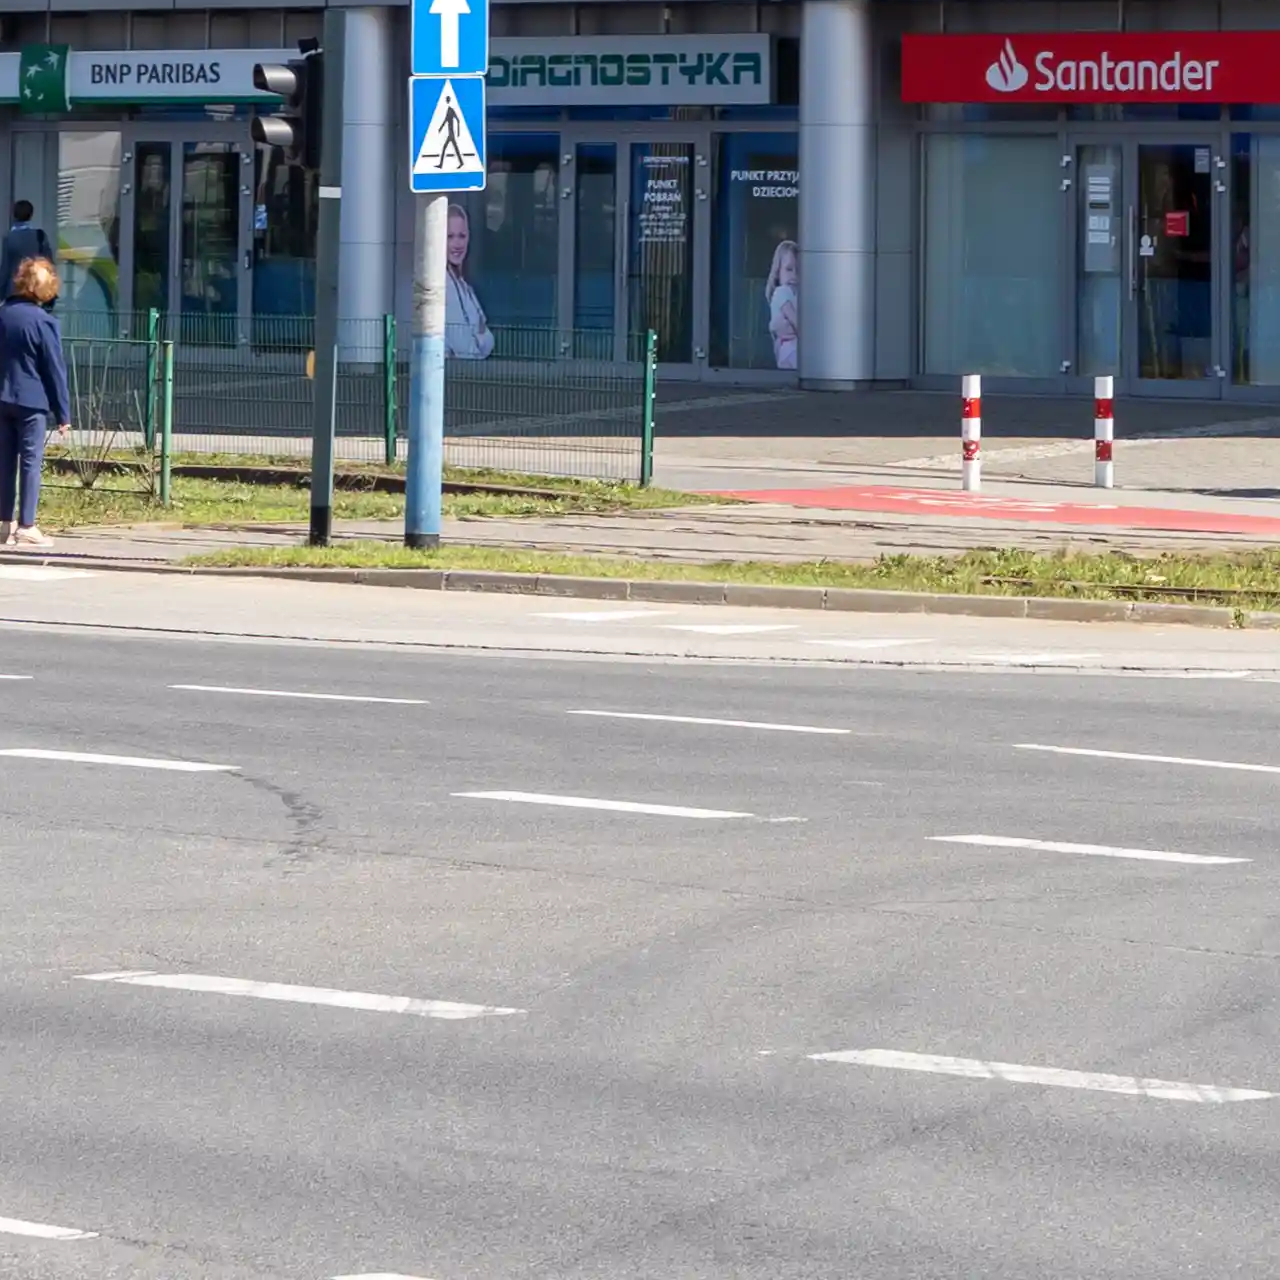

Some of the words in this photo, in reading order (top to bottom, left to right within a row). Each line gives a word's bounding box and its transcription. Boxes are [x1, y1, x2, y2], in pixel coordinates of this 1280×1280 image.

[91, 63, 132, 84] BNP
[136, 62, 221, 84] PARIBAS
[1035, 51, 1219, 91] Santander
[730, 170, 765, 181] PUNKT
